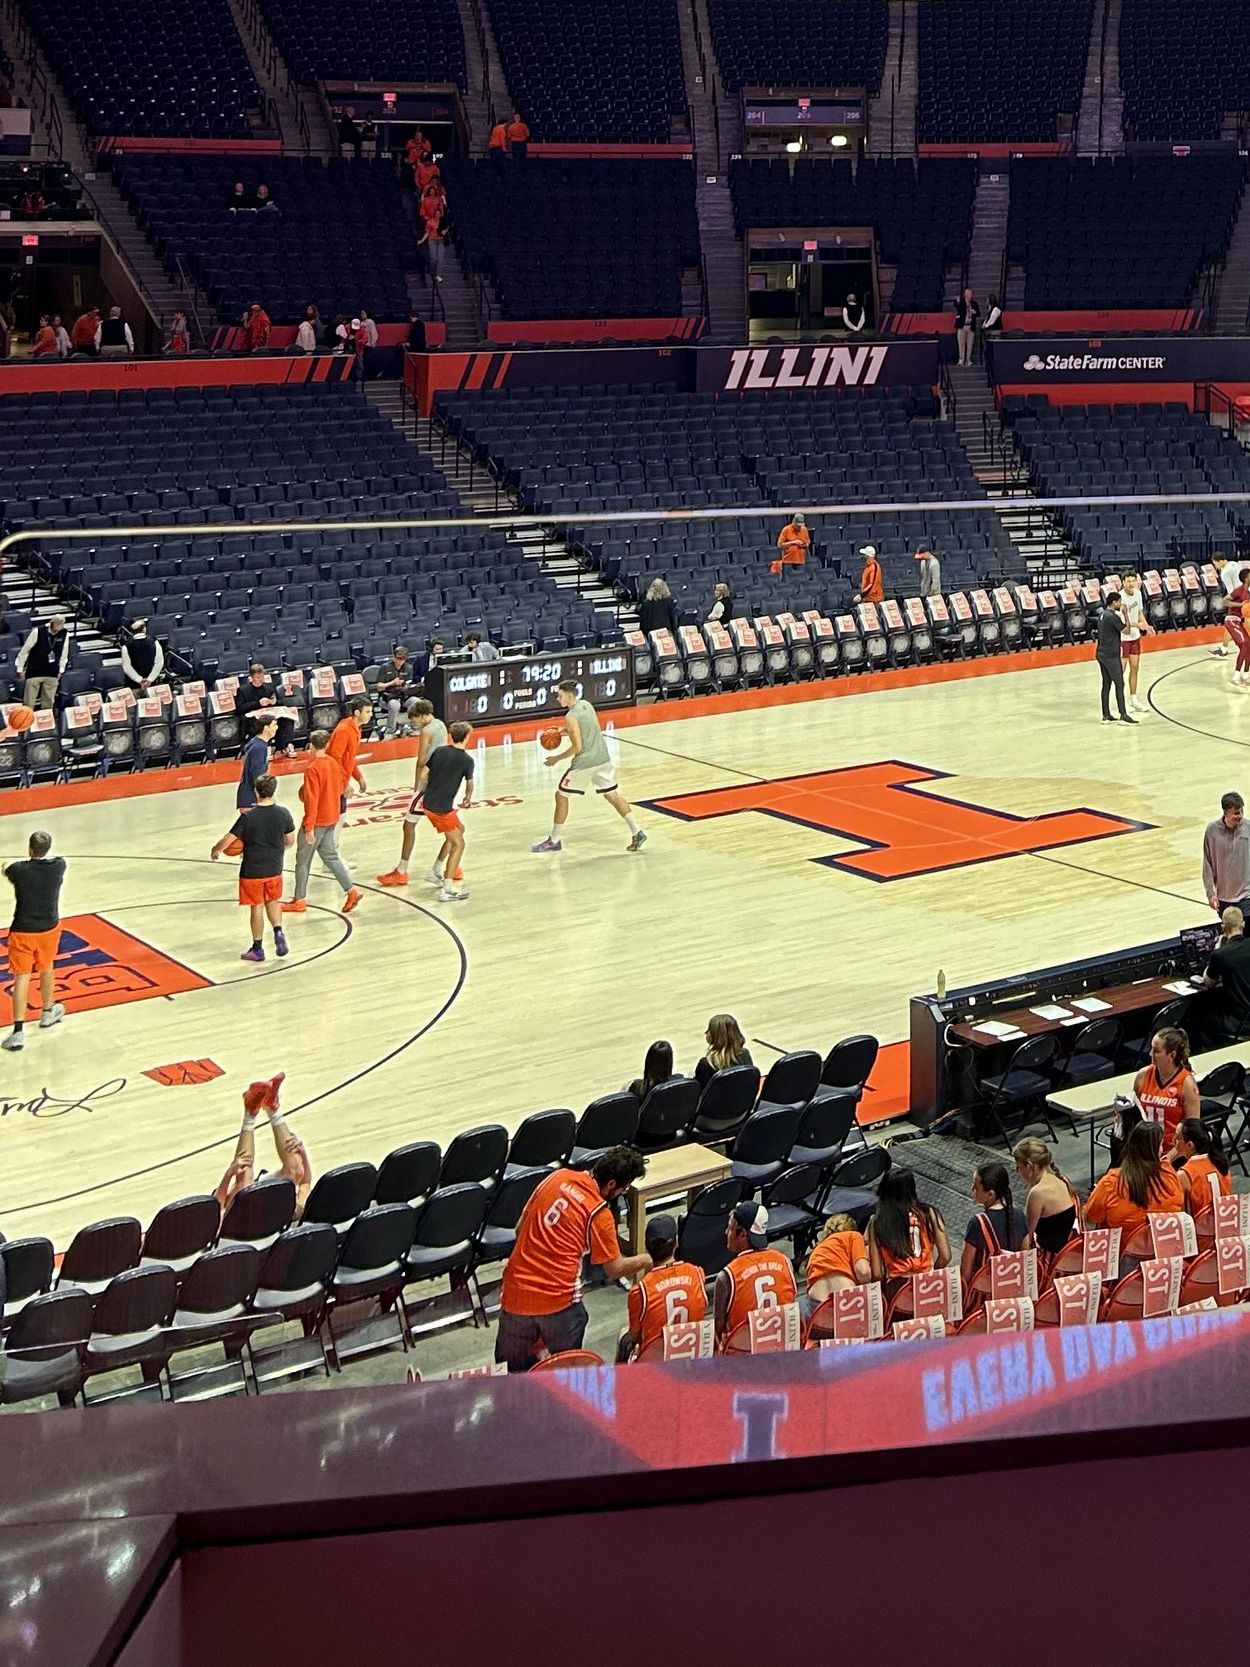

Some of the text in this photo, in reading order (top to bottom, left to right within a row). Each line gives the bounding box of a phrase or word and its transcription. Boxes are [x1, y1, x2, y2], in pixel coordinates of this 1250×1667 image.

[723, 346, 889, 390] ILLINI
[522, 662, 562, 683] 79:20
[450, 674, 488, 692] COLGATE
[606, 679, 616, 697] 0
[476, 695, 488, 713] 0
[503, 692, 514, 710] 0
[536, 687, 547, 705] 0
[1139, 1092, 1177, 1107] ILLINOIS
[543, 1197, 569, 1227] 6
[753, 1274, 777, 1311] 6
[665, 1289, 690, 1326] 6
